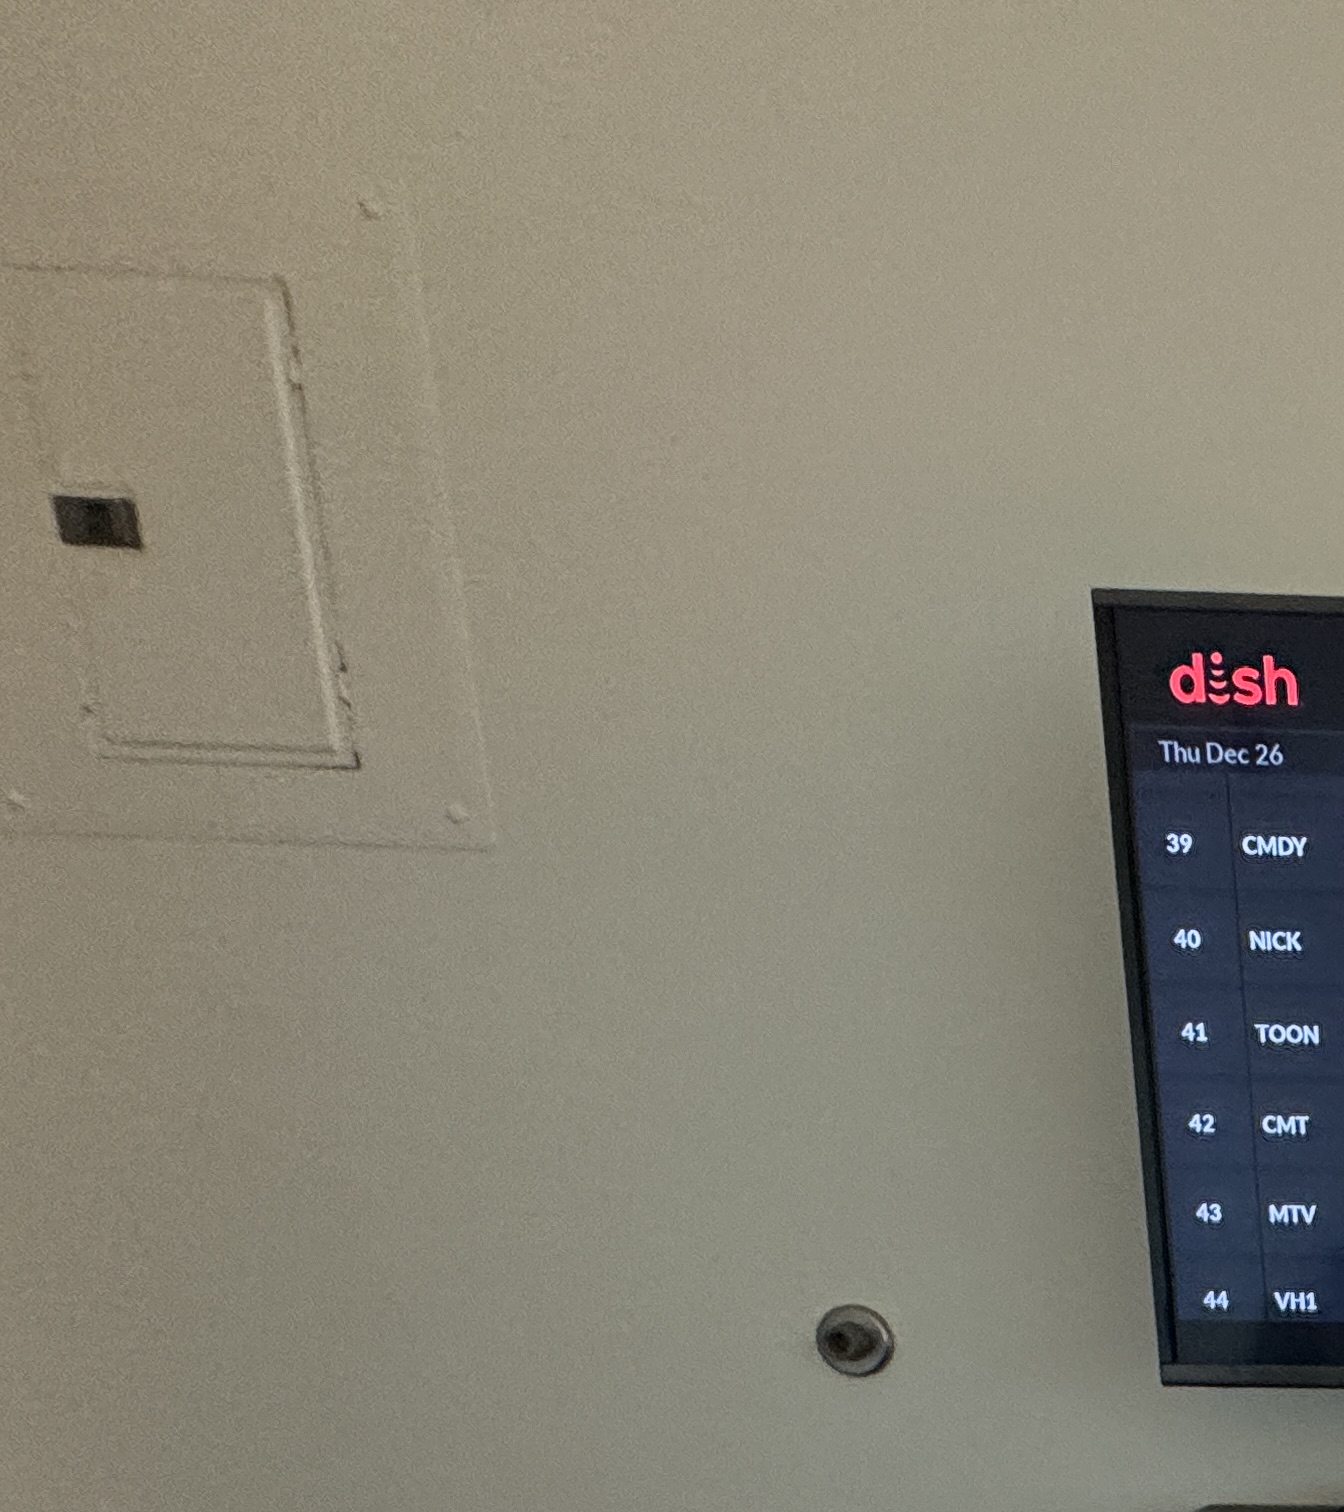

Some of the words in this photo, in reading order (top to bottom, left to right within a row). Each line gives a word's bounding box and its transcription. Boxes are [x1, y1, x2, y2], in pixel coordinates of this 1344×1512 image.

[1169, 651, 1299, 706] dish
[1159, 738, 1201, 764] Thu
[1206, 740, 1250, 764] Dec
[1255, 742, 1283, 765] 26
[1166, 831, 1193, 854] 39
[1242, 834, 1306, 857] CMDY
[1173, 927, 1200, 949] 40
[1250, 929, 1302, 951] NICK
[1181, 1022, 1207, 1043] 41
[1254, 1022, 1320, 1045] TOON
[1188, 1113, 1215, 1134] 42
[1262, 1113, 1309, 1135] CMT
[1195, 1202, 1222, 1223] 43
[1269, 1203, 1316, 1224] MTV
[1203, 1289, 1228, 1310] 44
[1274, 1290, 1316, 1311] VH1
